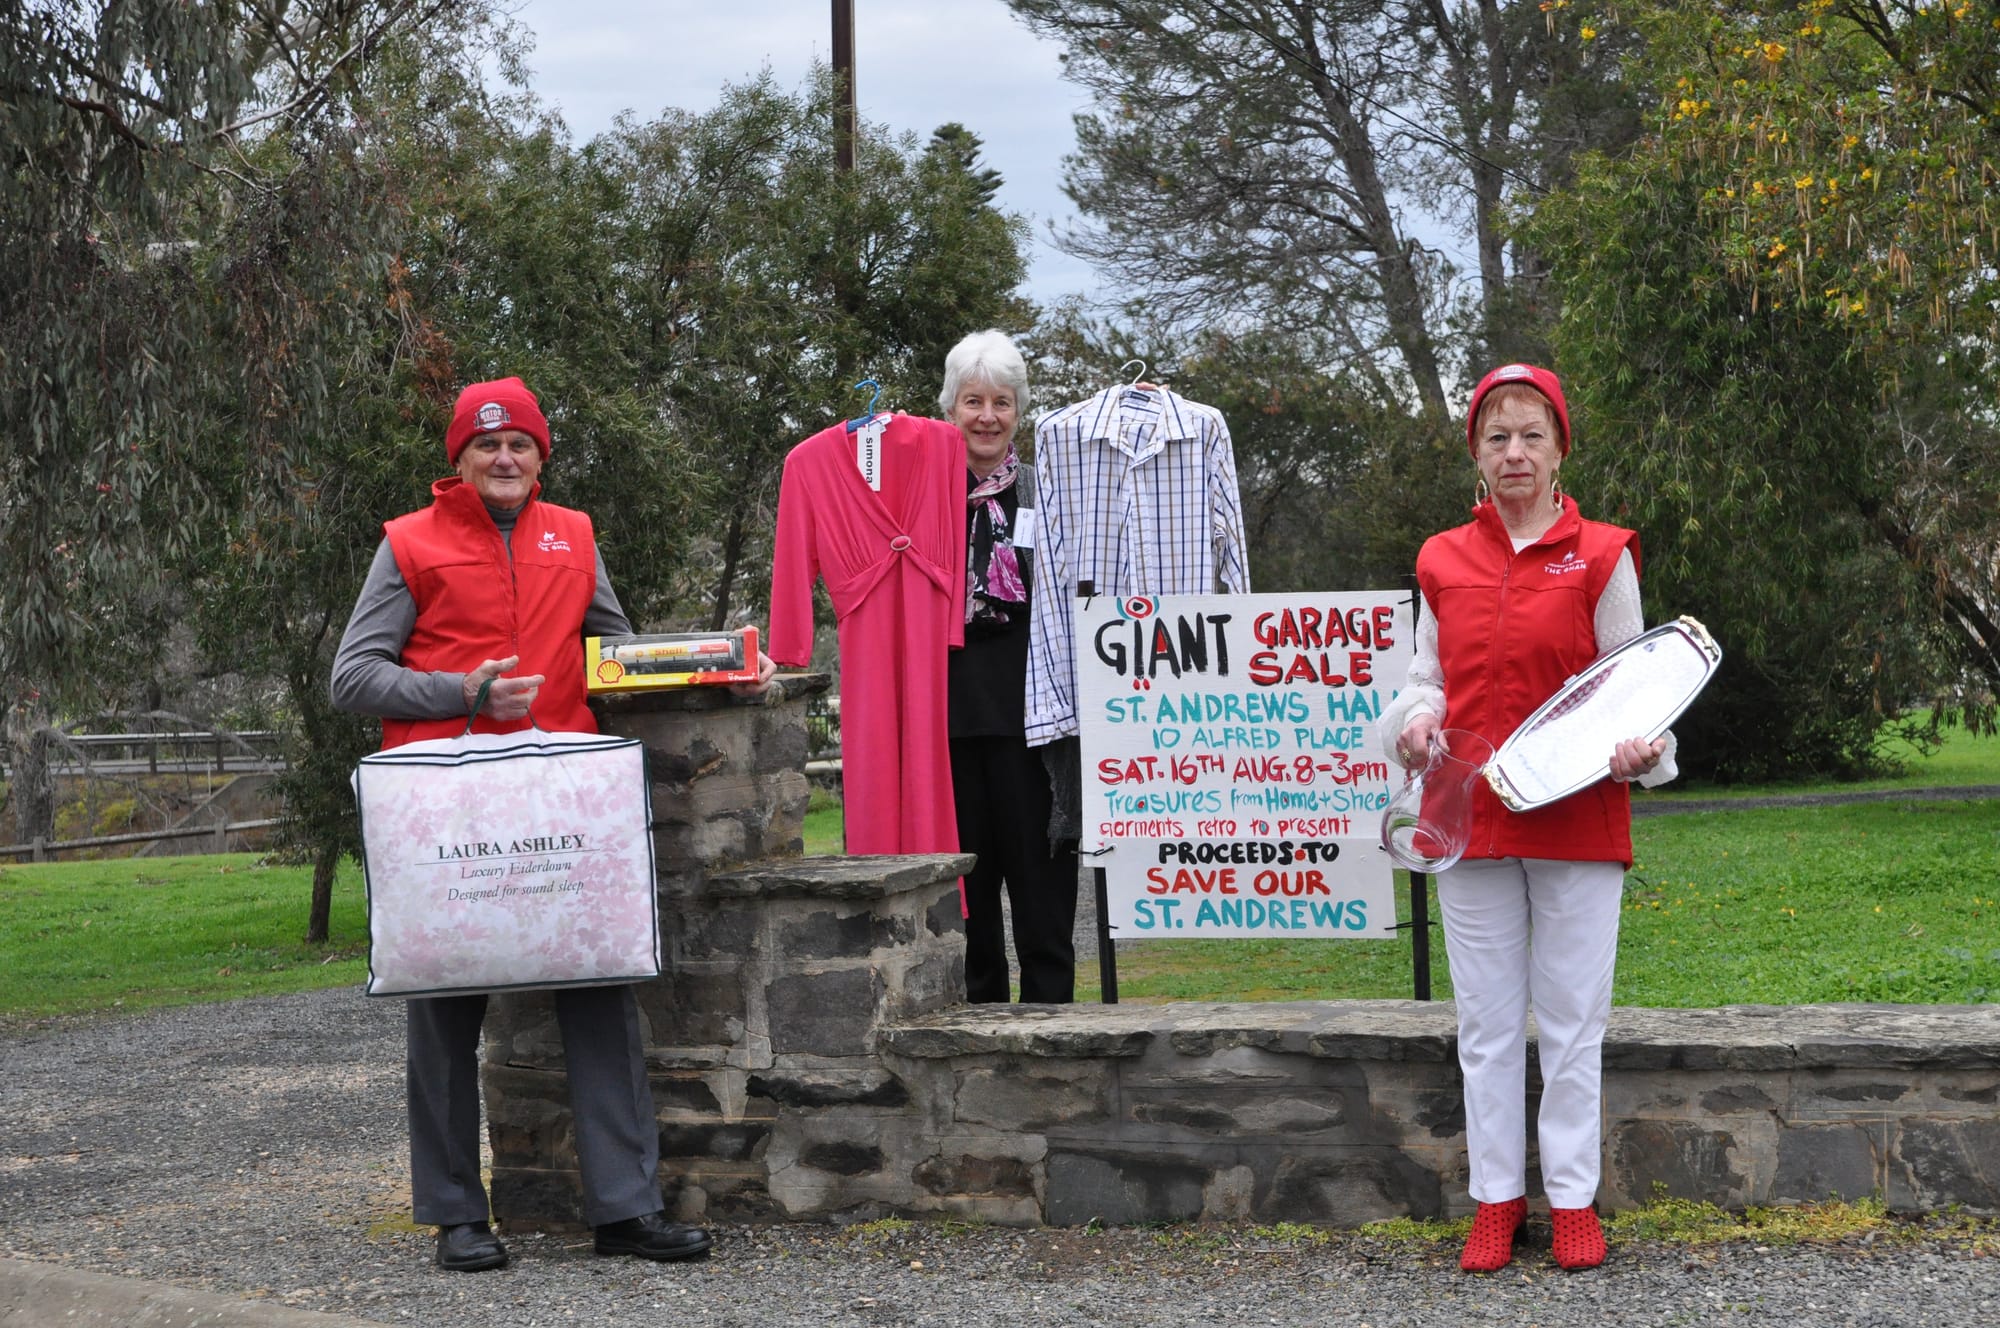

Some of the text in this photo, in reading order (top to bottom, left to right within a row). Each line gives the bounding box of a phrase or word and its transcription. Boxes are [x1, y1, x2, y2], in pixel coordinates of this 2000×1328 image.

[865, 437, 874, 484] simona
[1543, 566, 1562, 575] THE
[1253, 605, 1395, 650] GARAGE
[1094, 612, 1232, 680] GIANT
[1248, 650, 1374, 688] SALE
[1105, 689, 1399, 724] ST. ANDREWS HAL
[1152, 726, 1364, 750] 10 ALFRED PLACE
[1098, 757, 1164, 785] SAT.
[1170, 754, 1225, 785] 16TH
[1103, 789, 1222, 818] Treasures
[1230, 787, 1263, 814] from
[1197, 816, 1237, 837] retro
[1249, 818, 1270, 835] to
[1278, 816, 1352, 837] present
[438, 834, 586, 860] LAURA ASHLEY
[1158, 841, 1340, 865] PROCEEDS TO
[461, 859, 572, 880] Luxury Eiderdown
[1146, 867, 1331, 896] SAVE OUR
[448, 879, 584, 904] Designed for sound sleep
[1134, 898, 1368, 931] ST. ANDREWS
